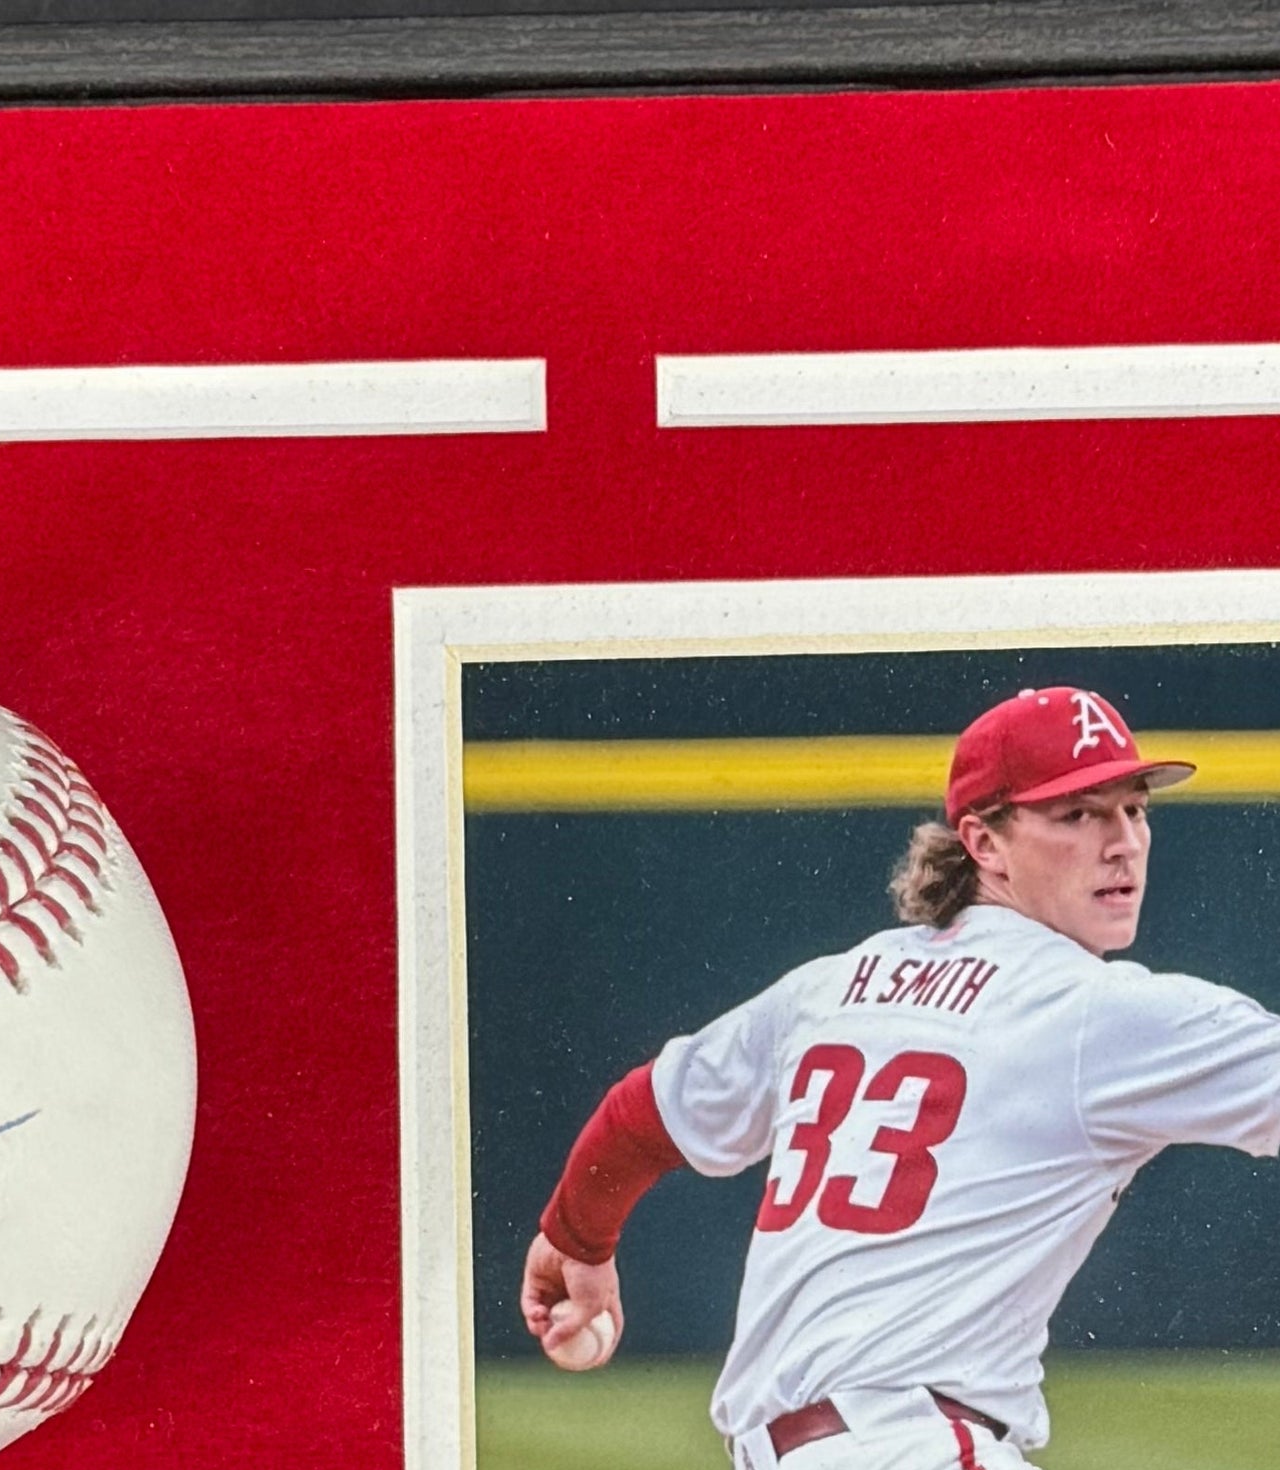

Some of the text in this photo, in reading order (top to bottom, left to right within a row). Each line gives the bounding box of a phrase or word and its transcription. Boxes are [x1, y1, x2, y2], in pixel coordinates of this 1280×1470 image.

[1070, 692, 1127, 759] A
[840, 955, 999, 1015] H. SMITH
[756, 1043, 968, 1235] 33
